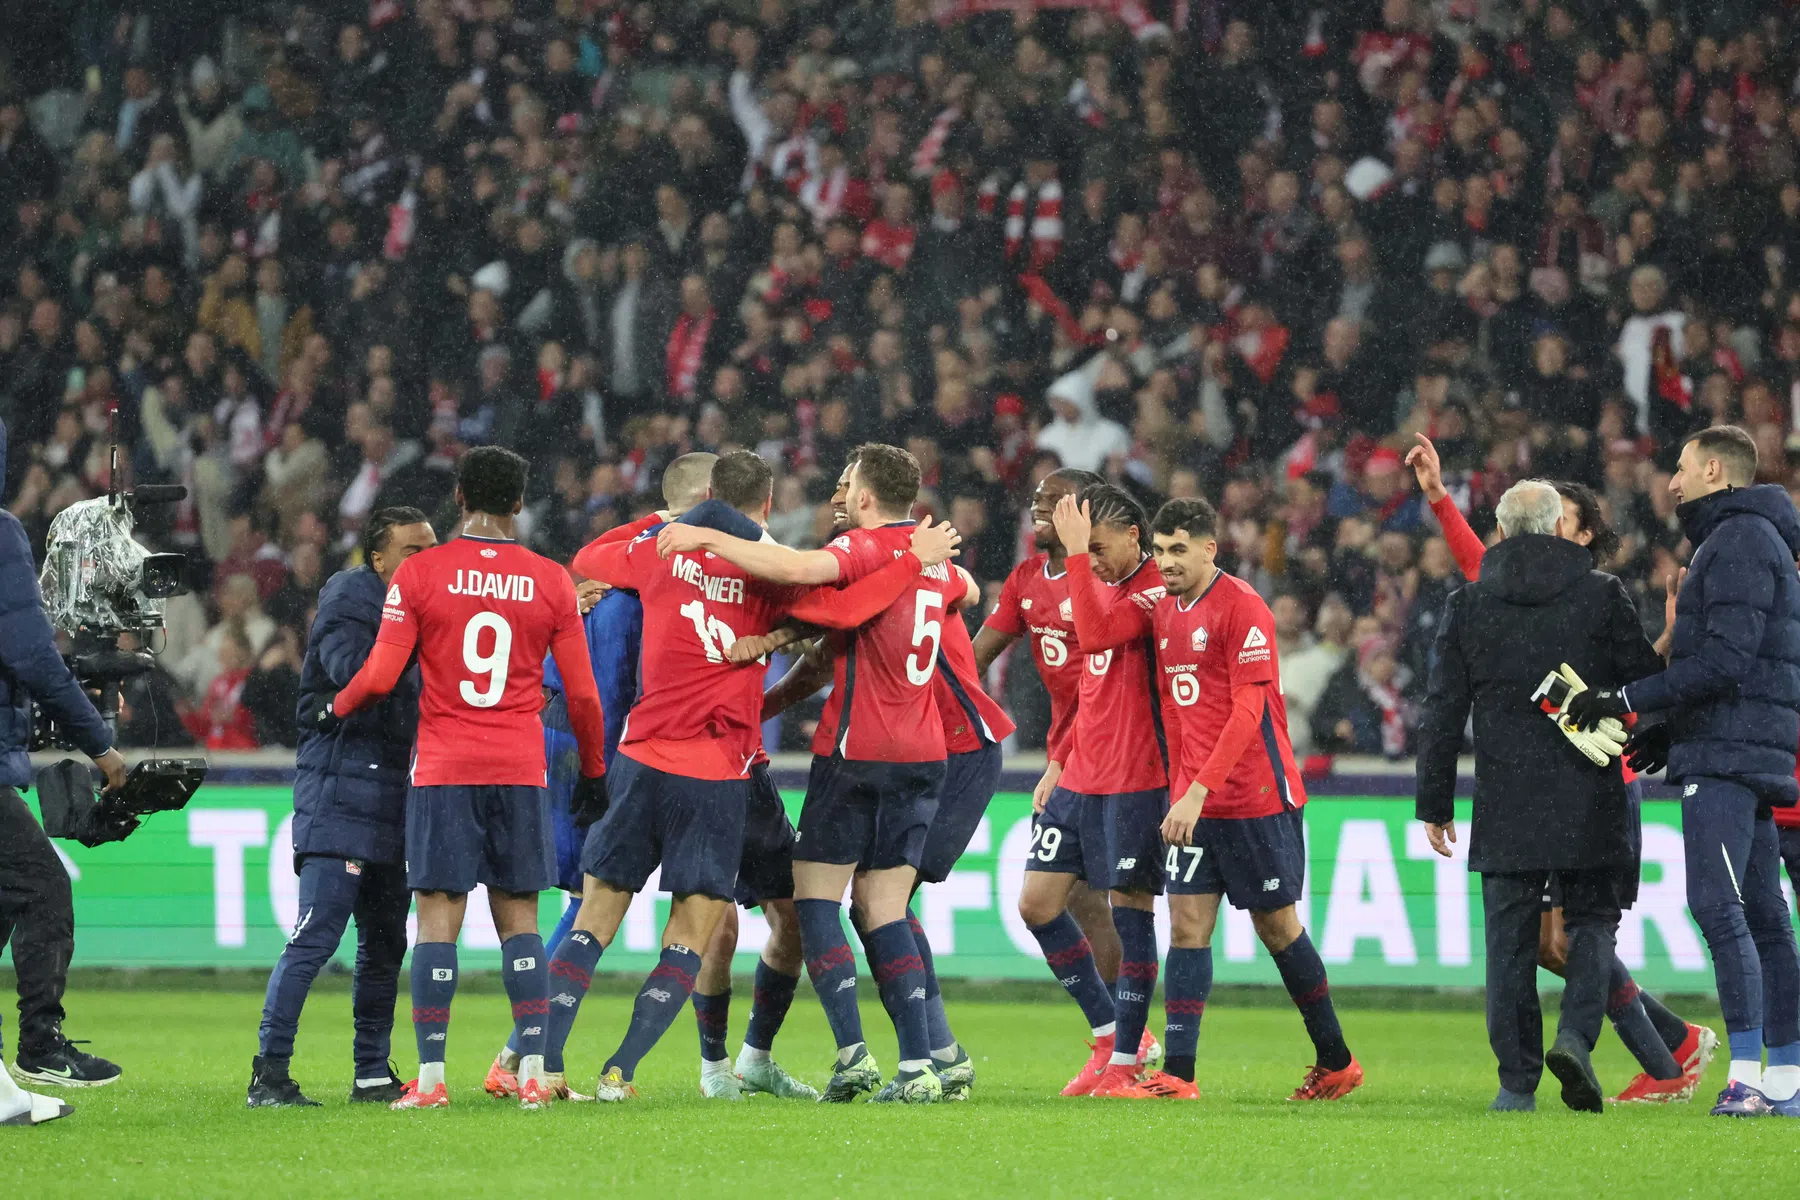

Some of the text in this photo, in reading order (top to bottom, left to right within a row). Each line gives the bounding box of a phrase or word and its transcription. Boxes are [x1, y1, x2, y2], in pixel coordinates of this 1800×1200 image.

[447, 569, 534, 602] J.DAVID
[906, 589, 943, 686] 5
[459, 611, 512, 708] 9
[1164, 664, 1198, 674] boulanger
[1028, 824, 1063, 863] 29
[1165, 846, 1204, 883] 47
[438, 970, 447, 980] 9
[519, 960, 529, 969] 9
[1118, 989, 1145, 1003] LOSC
